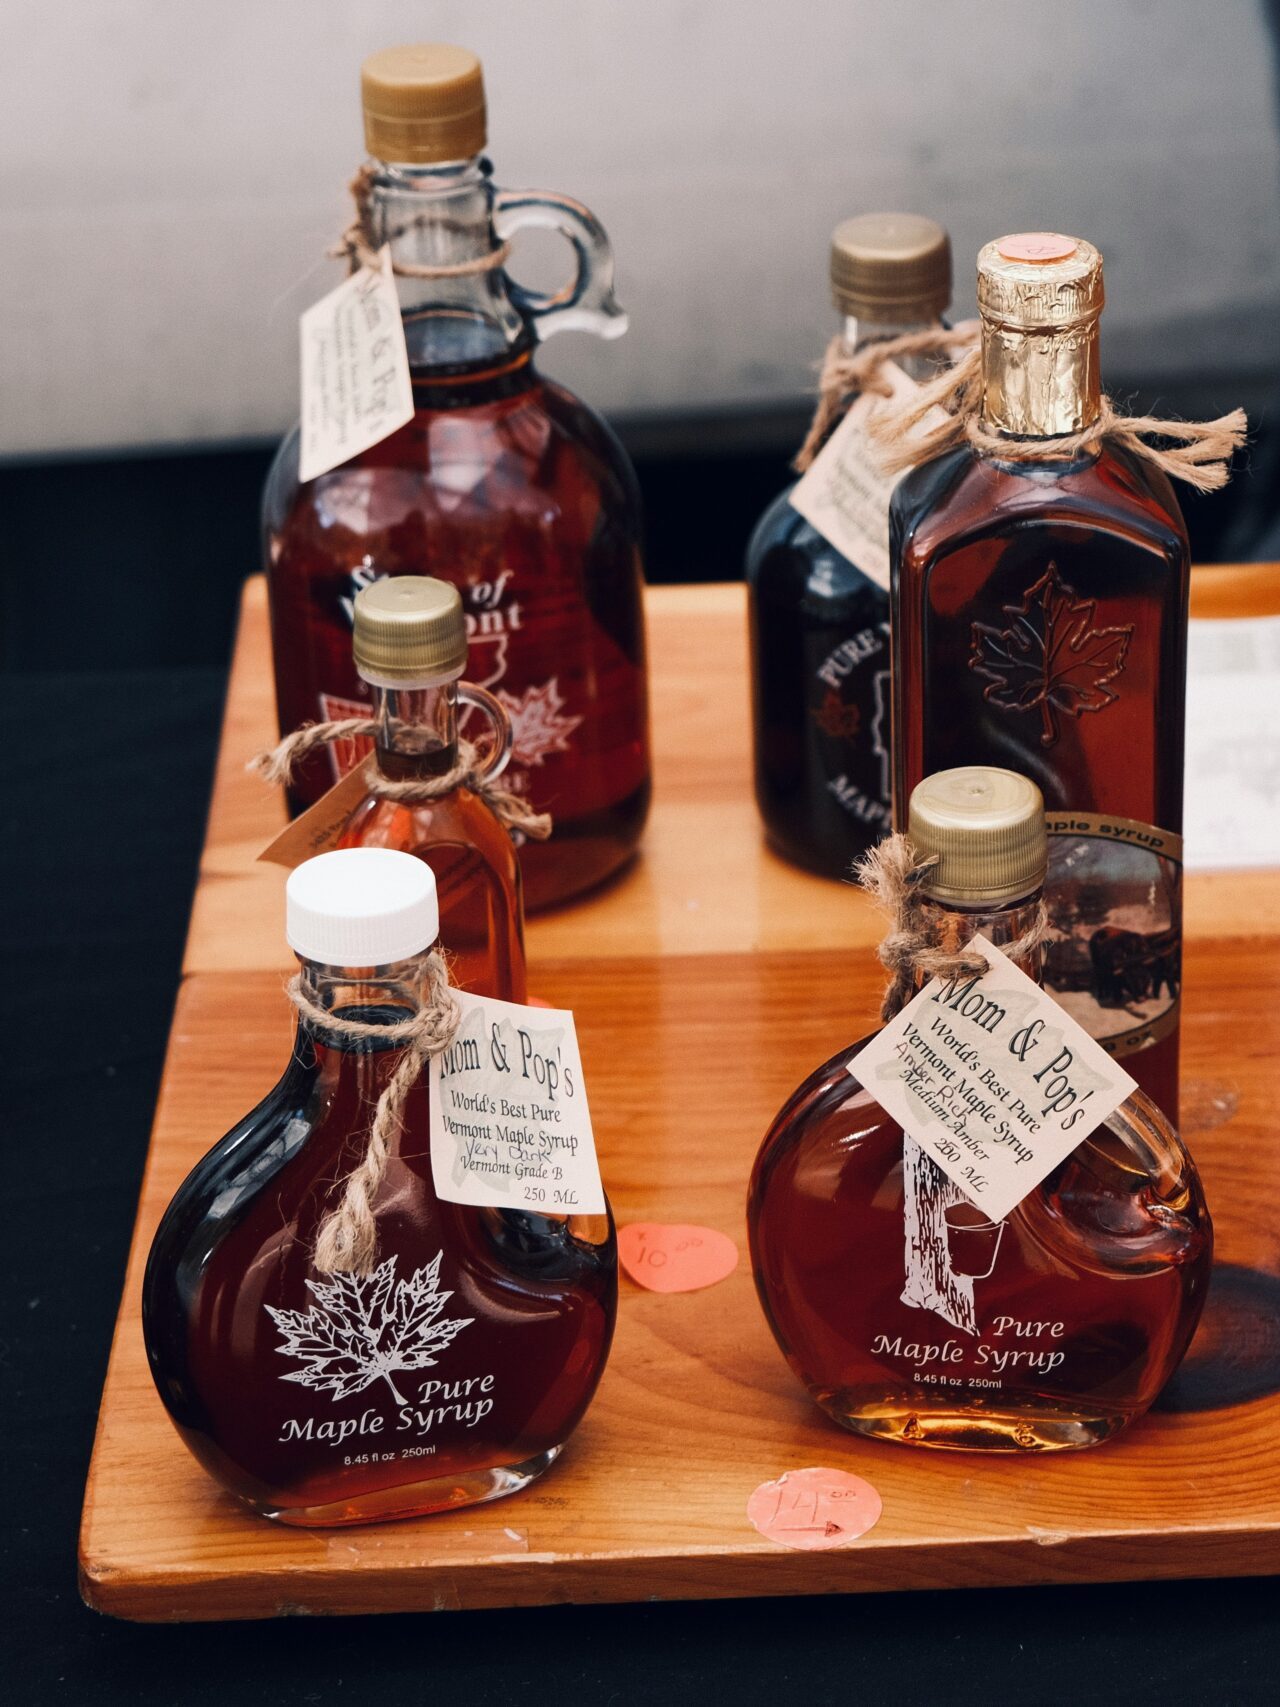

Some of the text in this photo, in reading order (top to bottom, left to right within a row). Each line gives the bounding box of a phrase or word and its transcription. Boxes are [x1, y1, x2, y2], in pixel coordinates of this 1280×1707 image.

[471, 569, 514, 608] of
[817, 629, 883, 688] PURE
[1099, 824, 1165, 848] syrup
[490, 1022, 511, 1074] &
[517, 1029, 574, 1101] Pop's
[931, 974, 1095, 1131] Mom & Pop's
[902, 1022, 1035, 1166] Vermont Maple Syrup
[930, 1016, 1042, 1135] World's Best Pure
[450, 1089, 562, 1123] World's Best Pure
[899, 1069, 990, 1162] Medium Amber
[442, 1115, 579, 1157] Vermont Maple Syrup
[460, 1155, 564, 1181] Vermont Grade B
[960, 1165, 990, 1193] ML
[524, 1186, 579, 1205] 250 ML
[992, 1316, 1066, 1339] Pure
[870, 1334, 1066, 1375] Maple Syrup
[417, 1374, 496, 1405] Pure
[913, 1373, 1002, 1389] 8.45 fl oz 250ml
[278, 1397, 495, 1447] Maple Syrup
[344, 1444, 437, 1466] 8.45 fl oz 250ml
